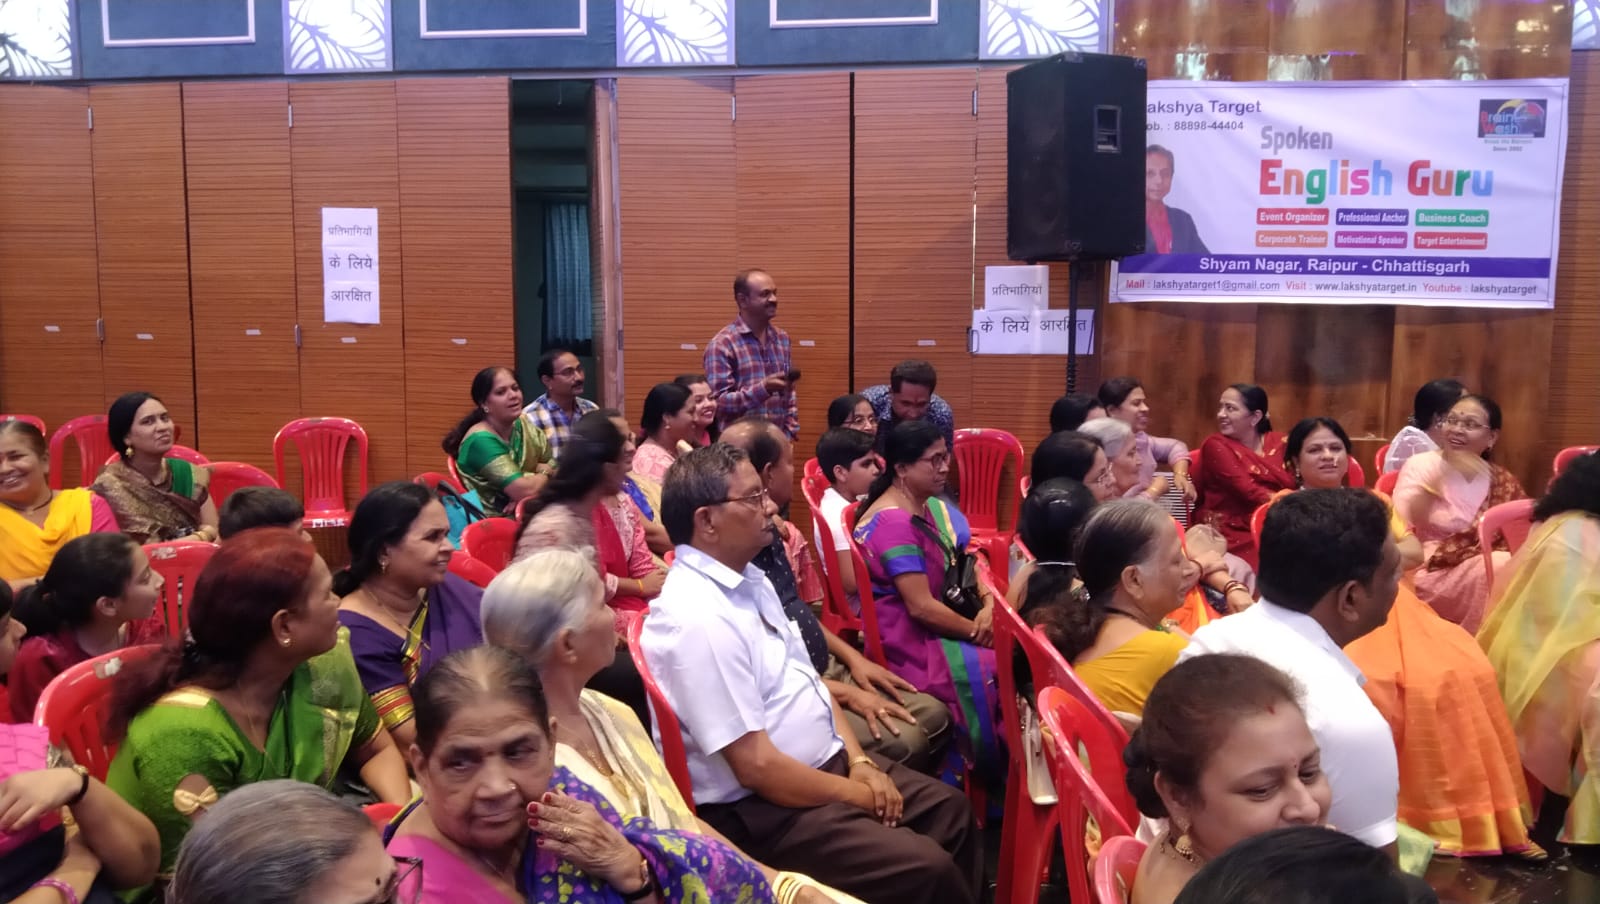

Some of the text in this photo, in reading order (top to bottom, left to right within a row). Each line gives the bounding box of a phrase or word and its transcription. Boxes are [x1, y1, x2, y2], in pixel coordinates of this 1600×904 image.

[1147, 100, 1262, 116] akshya Target
[1146, 121, 1163, 131] ob.
[1174, 121, 1244, 131] 88898-44404
[1261, 125, 1333, 155] Spoken
[1259, 159, 1494, 205] English Guru
[1260, 211, 1326, 224] Event Organizer
[1338, 212, 1407, 223] Professional Anchor
[1418, 213, 1486, 223] Business Coach
[1258, 234, 1326, 245] Corporate Trainer
[1417, 236, 1438, 247] Target
[329, 253, 373, 270] के लिये
[1199, 257, 1250, 272] Shyam
[1255, 258, 1303, 274] Nagar,
[1307, 259, 1358, 274] Raipur
[1371, 259, 1470, 275] Chhattisgarh
[330, 287, 372, 302] आरक्षित
[1125, 279, 1145, 289] Mail
[1153, 280, 1280, 291] lakshyatarget1@gmail.com
[1286, 280, 1307, 290] Visit
[1315, 282, 1417, 293] www.lakshyatarget.in
[1423, 283, 1462, 293] Youtube
[1470, 284, 1537, 295] lakshyatarget
[980, 316, 994, 333] के
[1002, 316, 1030, 333] लिये
